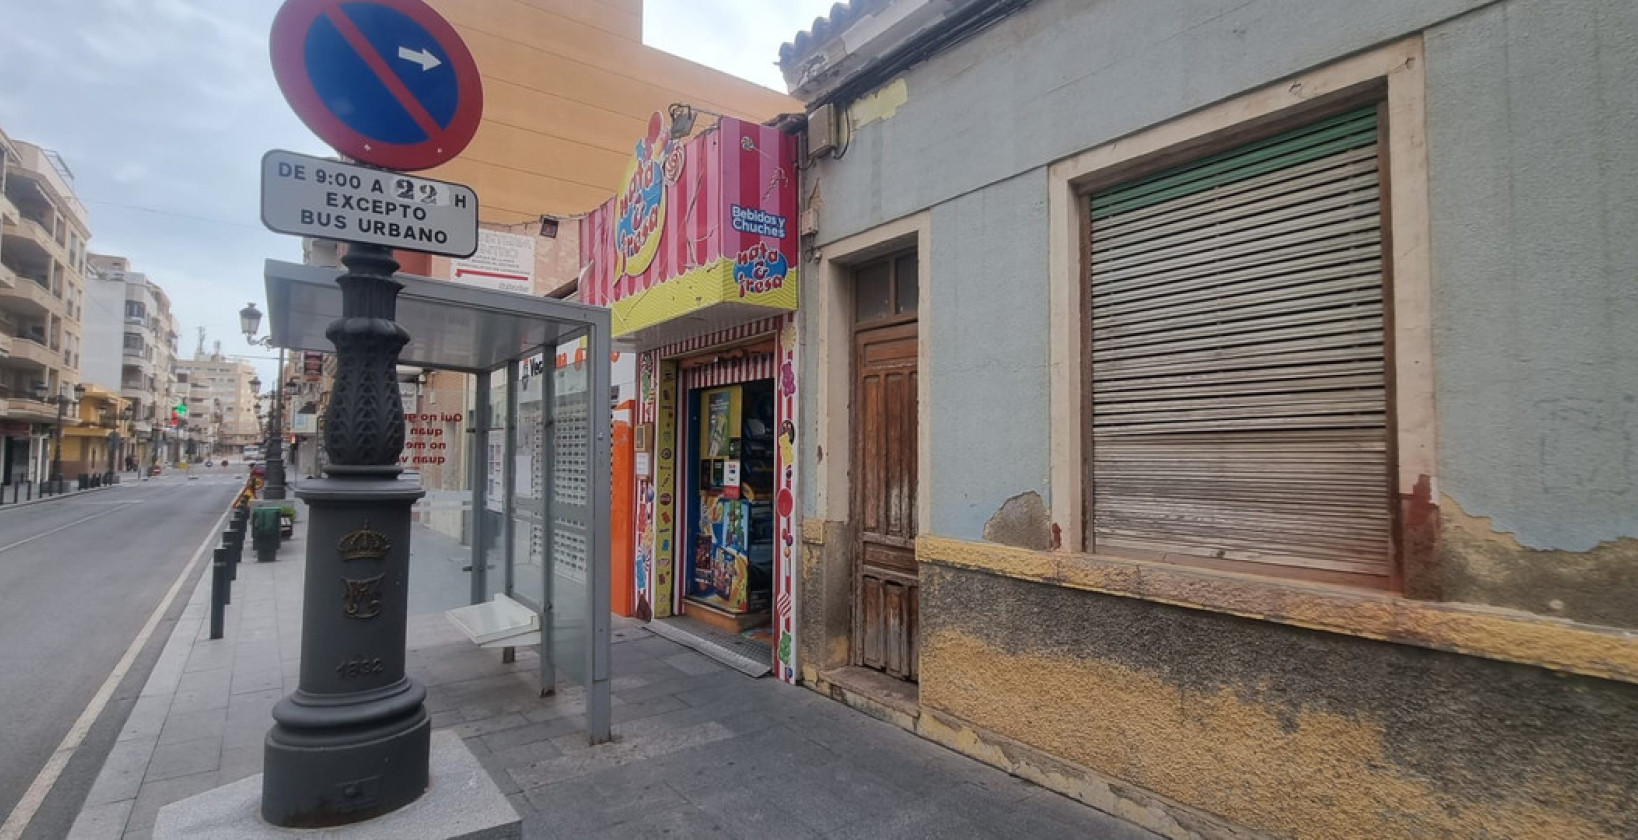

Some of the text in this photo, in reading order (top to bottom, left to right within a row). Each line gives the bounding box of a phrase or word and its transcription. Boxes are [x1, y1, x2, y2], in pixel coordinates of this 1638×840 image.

[278, 162, 467, 209] DE 9:00 A 22 H
[326, 192, 427, 222] EXCEPTO
[732, 206, 777, 225] Bebidas
[301, 209, 448, 245] BUS URBANO
[732, 218, 786, 239] Chuches
[737, 241, 779, 265] nata
[738, 272, 783, 298] fresa
